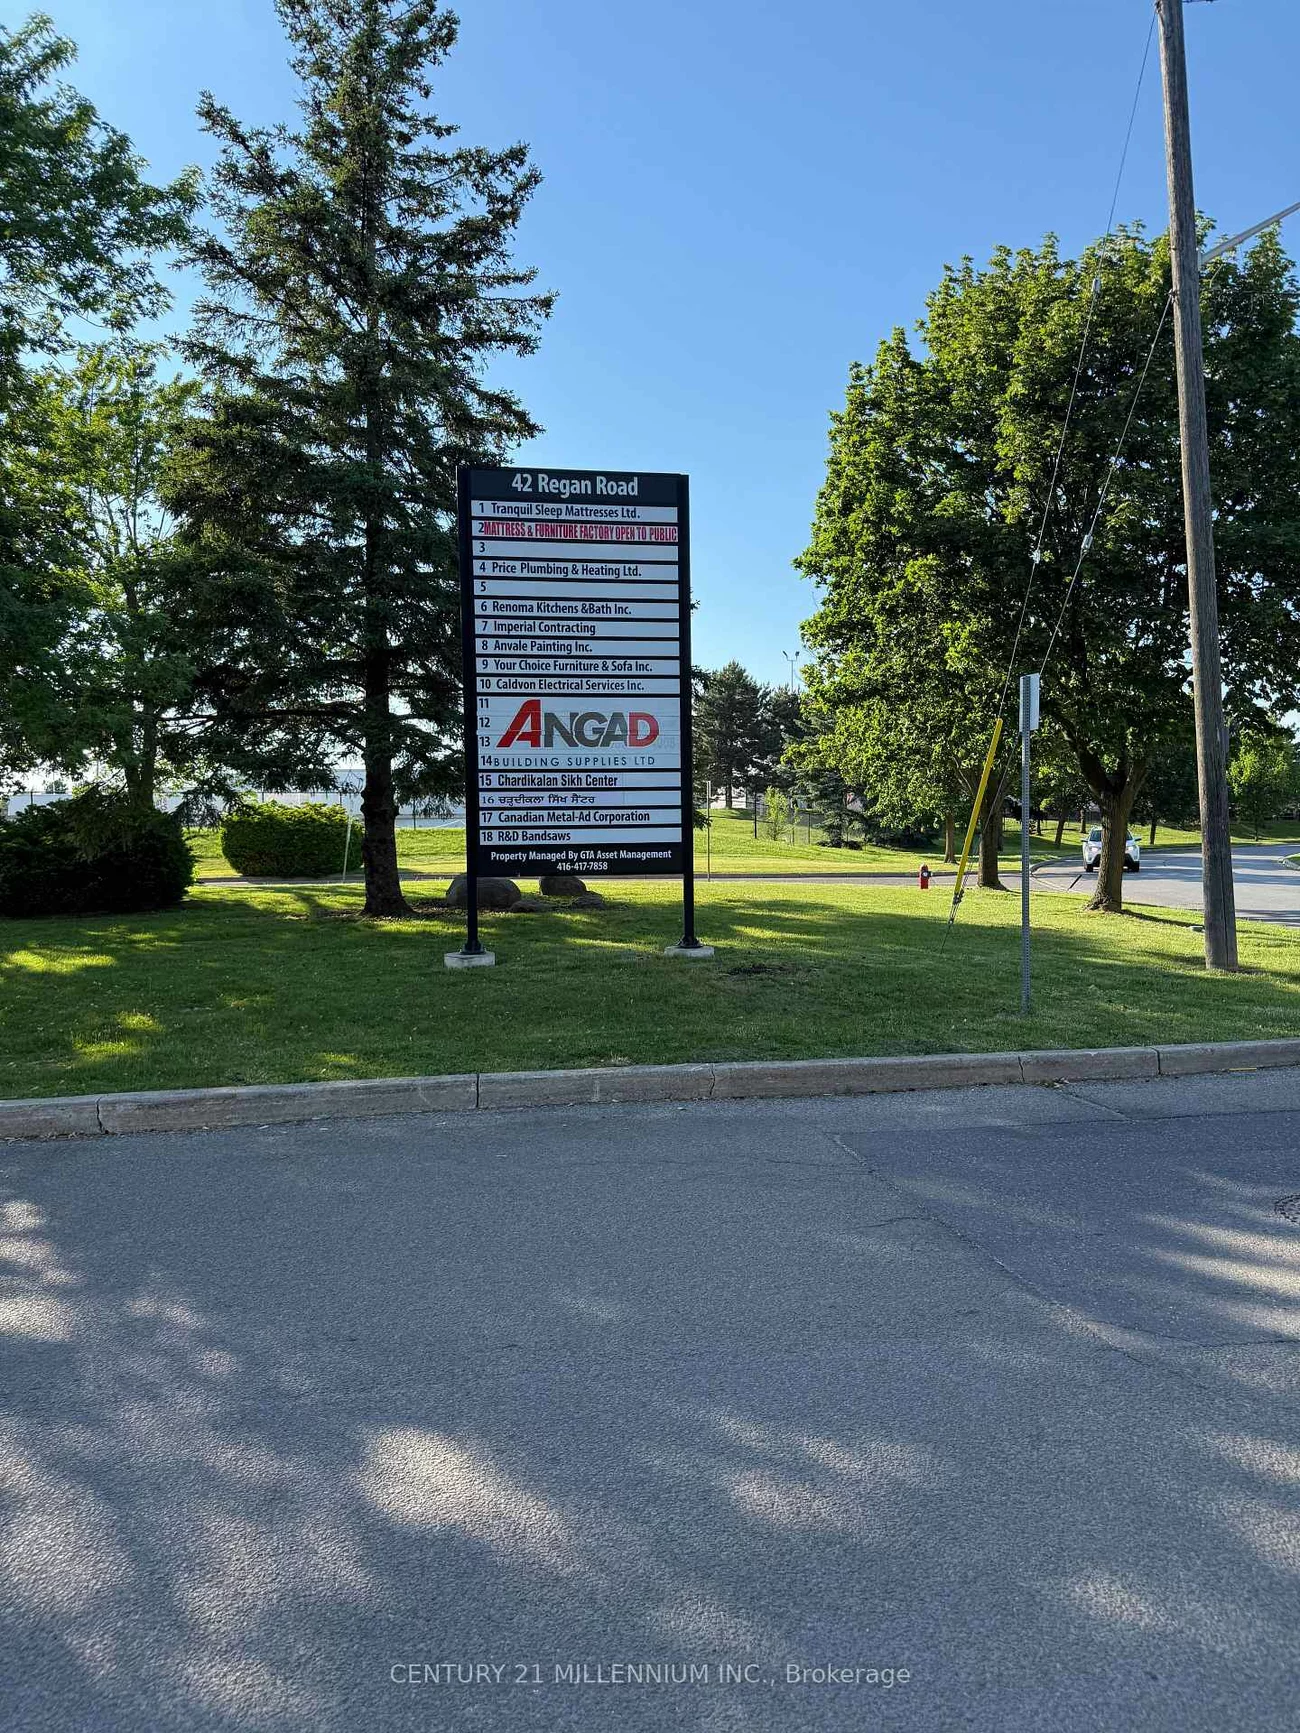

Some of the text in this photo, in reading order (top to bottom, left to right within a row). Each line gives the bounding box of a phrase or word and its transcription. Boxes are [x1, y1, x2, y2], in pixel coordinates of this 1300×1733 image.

[512, 474, 638, 498] 42 Regan Road
[479, 503, 640, 519] 1 Tranquil Sleep Mattresses Ltd.
[479, 522, 677, 541] 2 MATTRESS & FURNITURE FACTORY OPEN TO PUBLIC
[479, 542, 485, 553] 3
[480, 563, 641, 578] 4 Price Plumbing & Heating Ltd.
[480, 582, 486, 592] 5
[481, 601, 487, 611] 6
[493, 602, 533, 613] Renoma
[537, 602, 578, 614] Kitchens
[614, 604, 631, 614] Inc.
[482, 621, 596, 635] 7 Imperial Contracting
[482, 640, 592, 654] 8 Anvale Painting Inc.
[482, 660, 652, 672] 9 Your Choice Furniture & Sofa Inc.
[480, 679, 644, 690] 10 Caldvon Electrical Services Inc.
[479, 699, 489, 708] 11
[479, 718, 490, 727] 12
[496, 699, 659, 748] ANGAD
[480, 737, 490, 746] 13
[481, 756, 654, 767] 14 BUILDING SUPPLIES LTD
[480, 775, 618, 786] 15 Chardikalan Sikh Center
[482, 796, 494, 804] 16
[482, 811, 650, 824] 17 Canadian Metal-Ad Corporation
[482, 831, 570, 841] 18 R&D Bandsaws
[491, 850, 671, 862] Property Managed By GTA Asset Management
[557, 862, 607, 870] 416-417-7858
